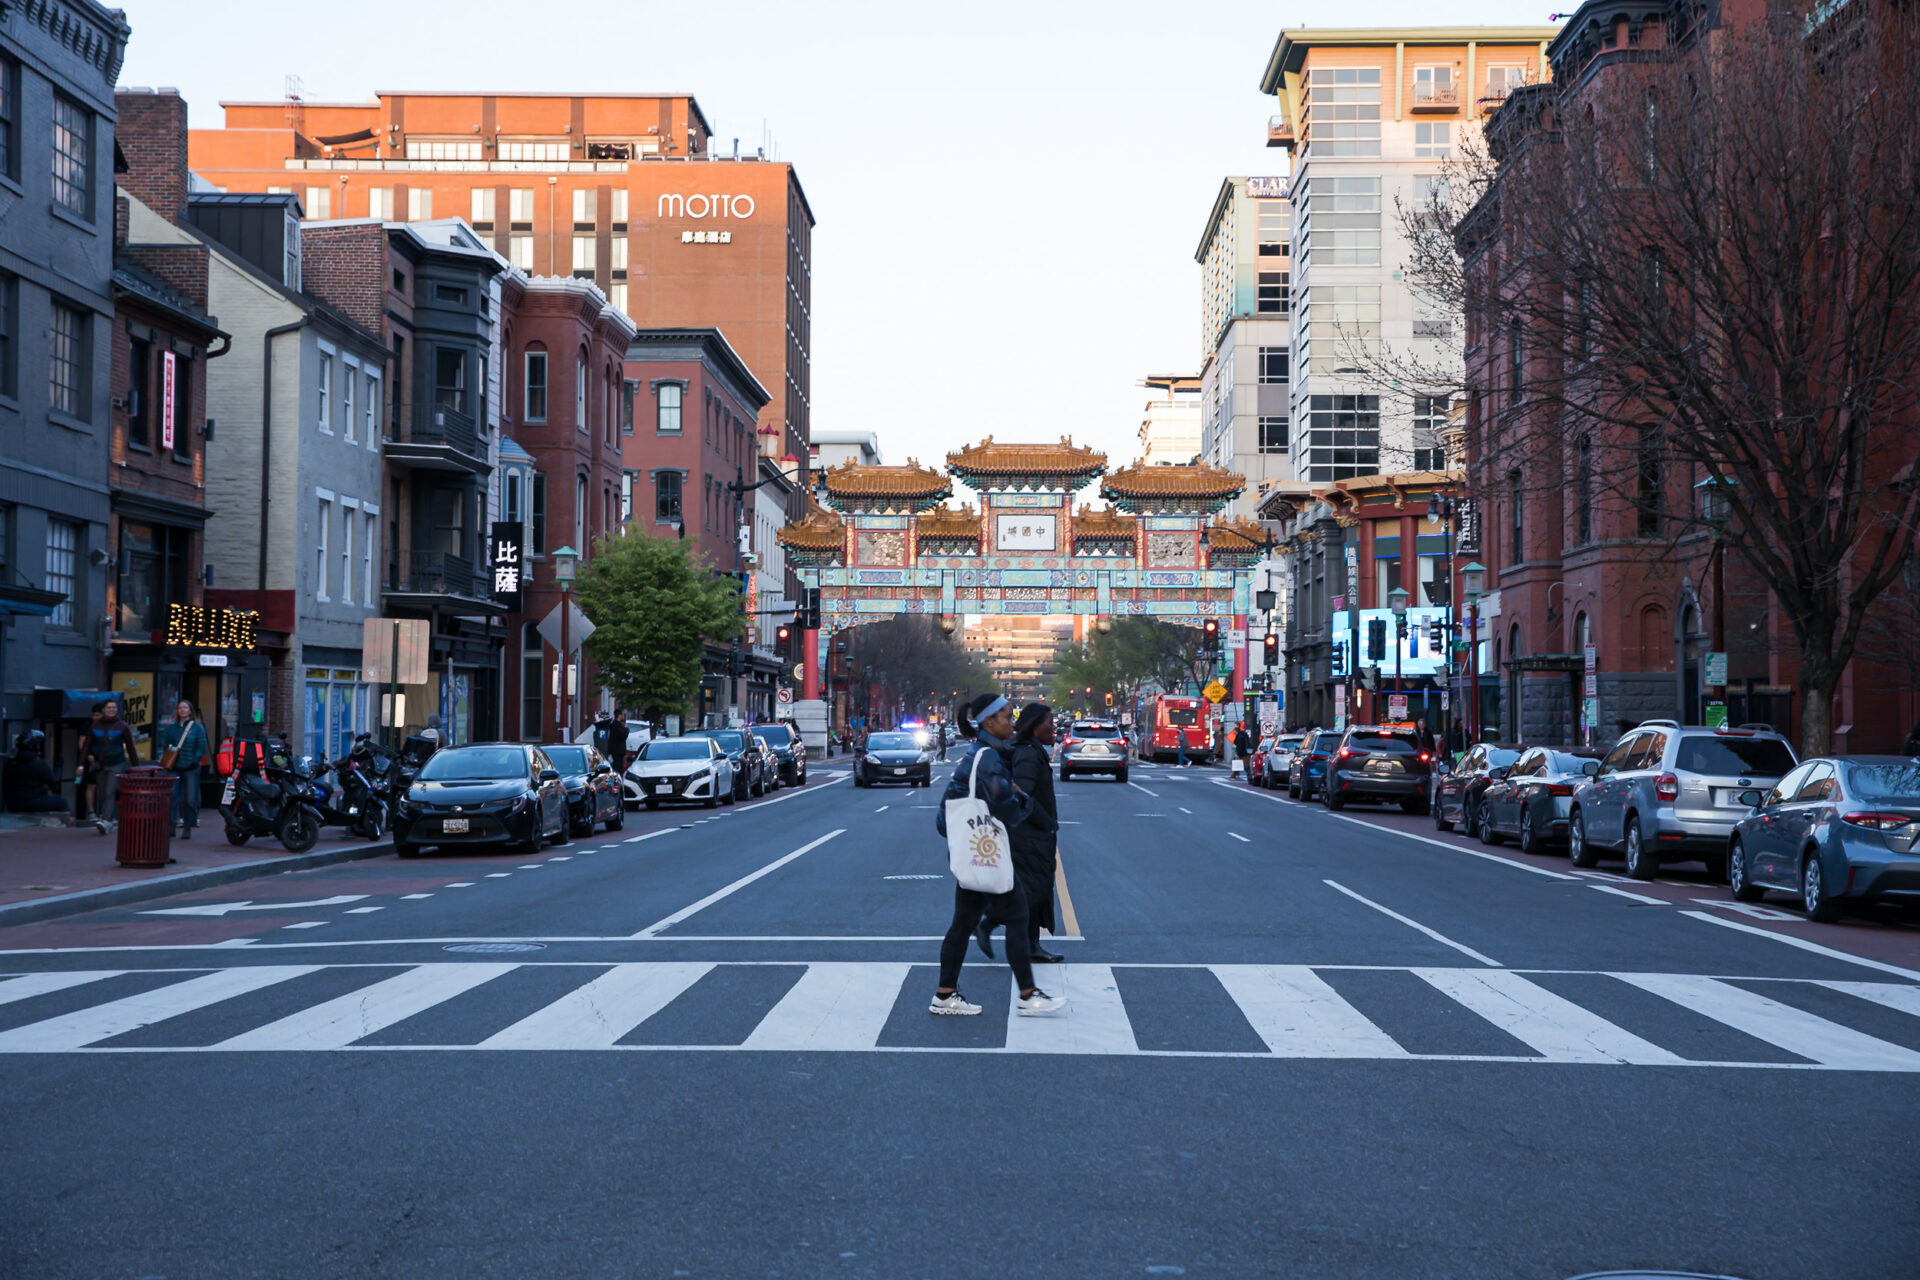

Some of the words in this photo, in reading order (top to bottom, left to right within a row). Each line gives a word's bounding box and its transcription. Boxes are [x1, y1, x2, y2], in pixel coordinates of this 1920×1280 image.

[1248, 178, 1289, 190] CLAR
[658, 194, 755, 218] MOTTO
[495, 541, 519, 593] 比薩
[166, 603, 260, 650] BULLDOG
[124, 694, 150, 713] APPY
[124, 709, 145, 726] OUR
